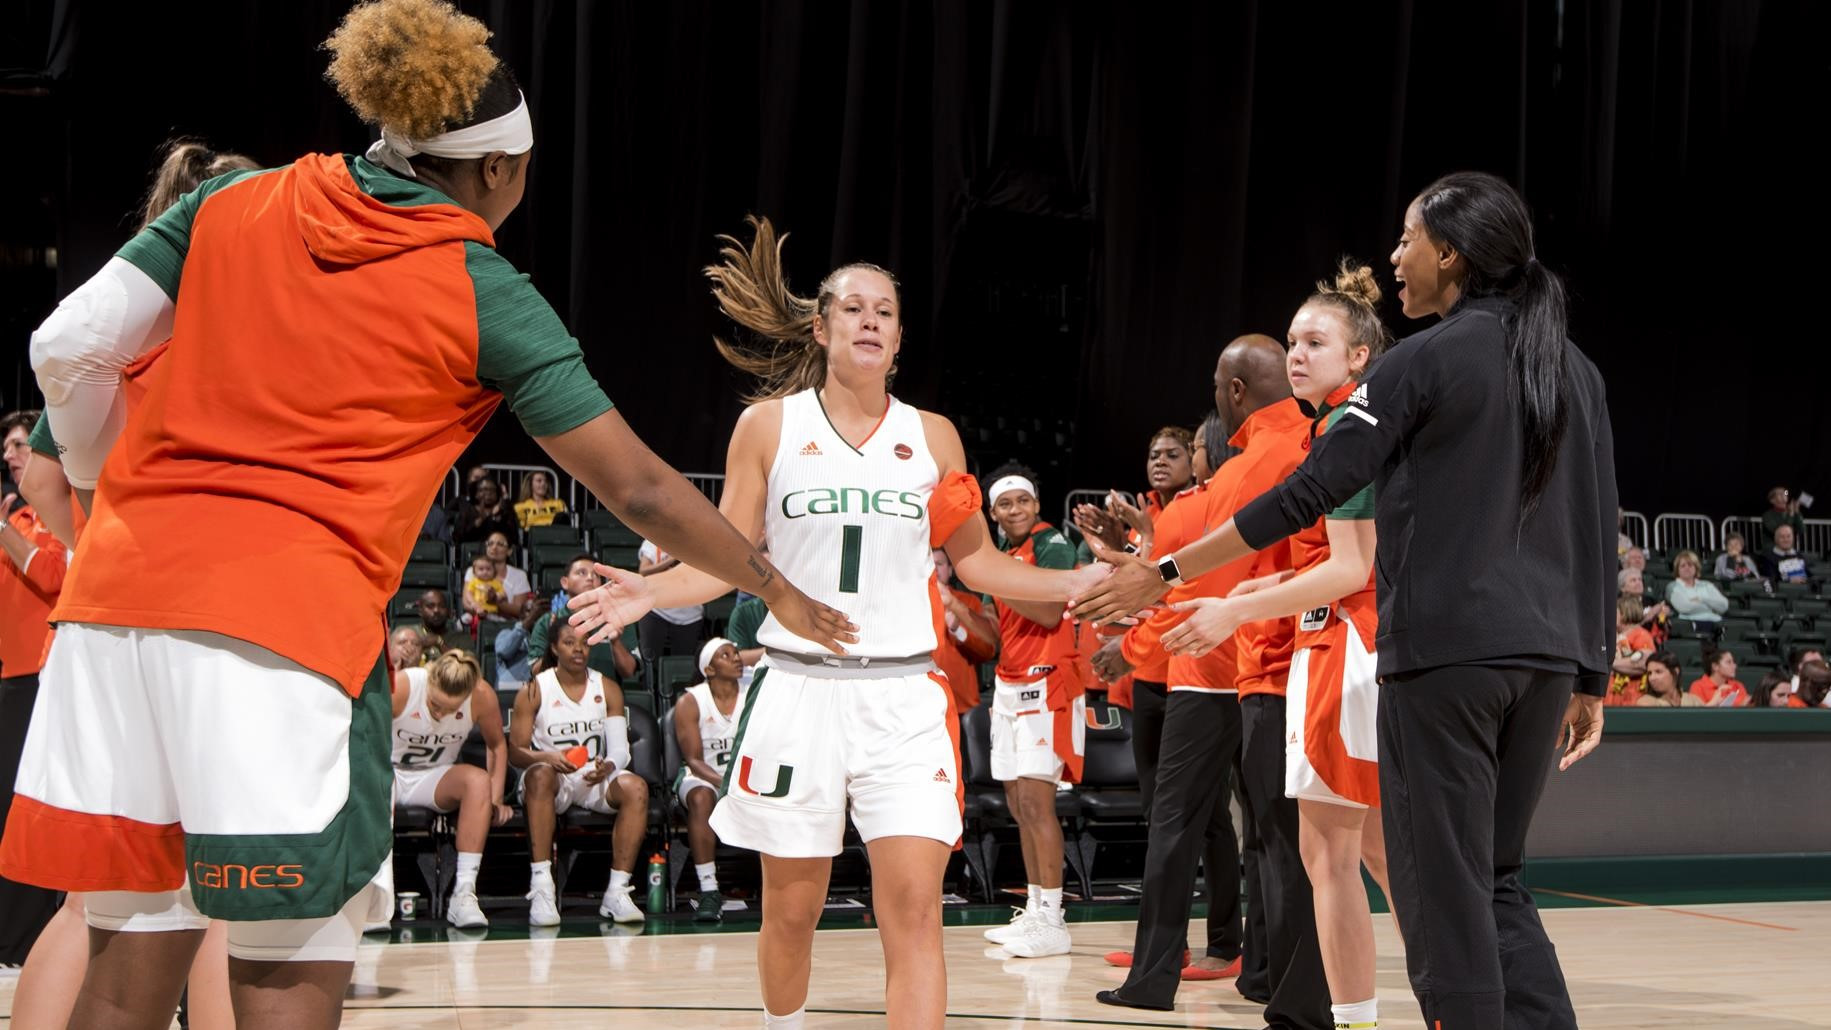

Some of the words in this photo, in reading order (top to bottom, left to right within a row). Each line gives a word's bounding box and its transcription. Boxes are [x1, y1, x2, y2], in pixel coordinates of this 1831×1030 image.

[839, 525, 863, 593] 1
[1085, 706, 1122, 730] U
[400, 746, 446, 766] 21
[738, 755, 794, 798] U
